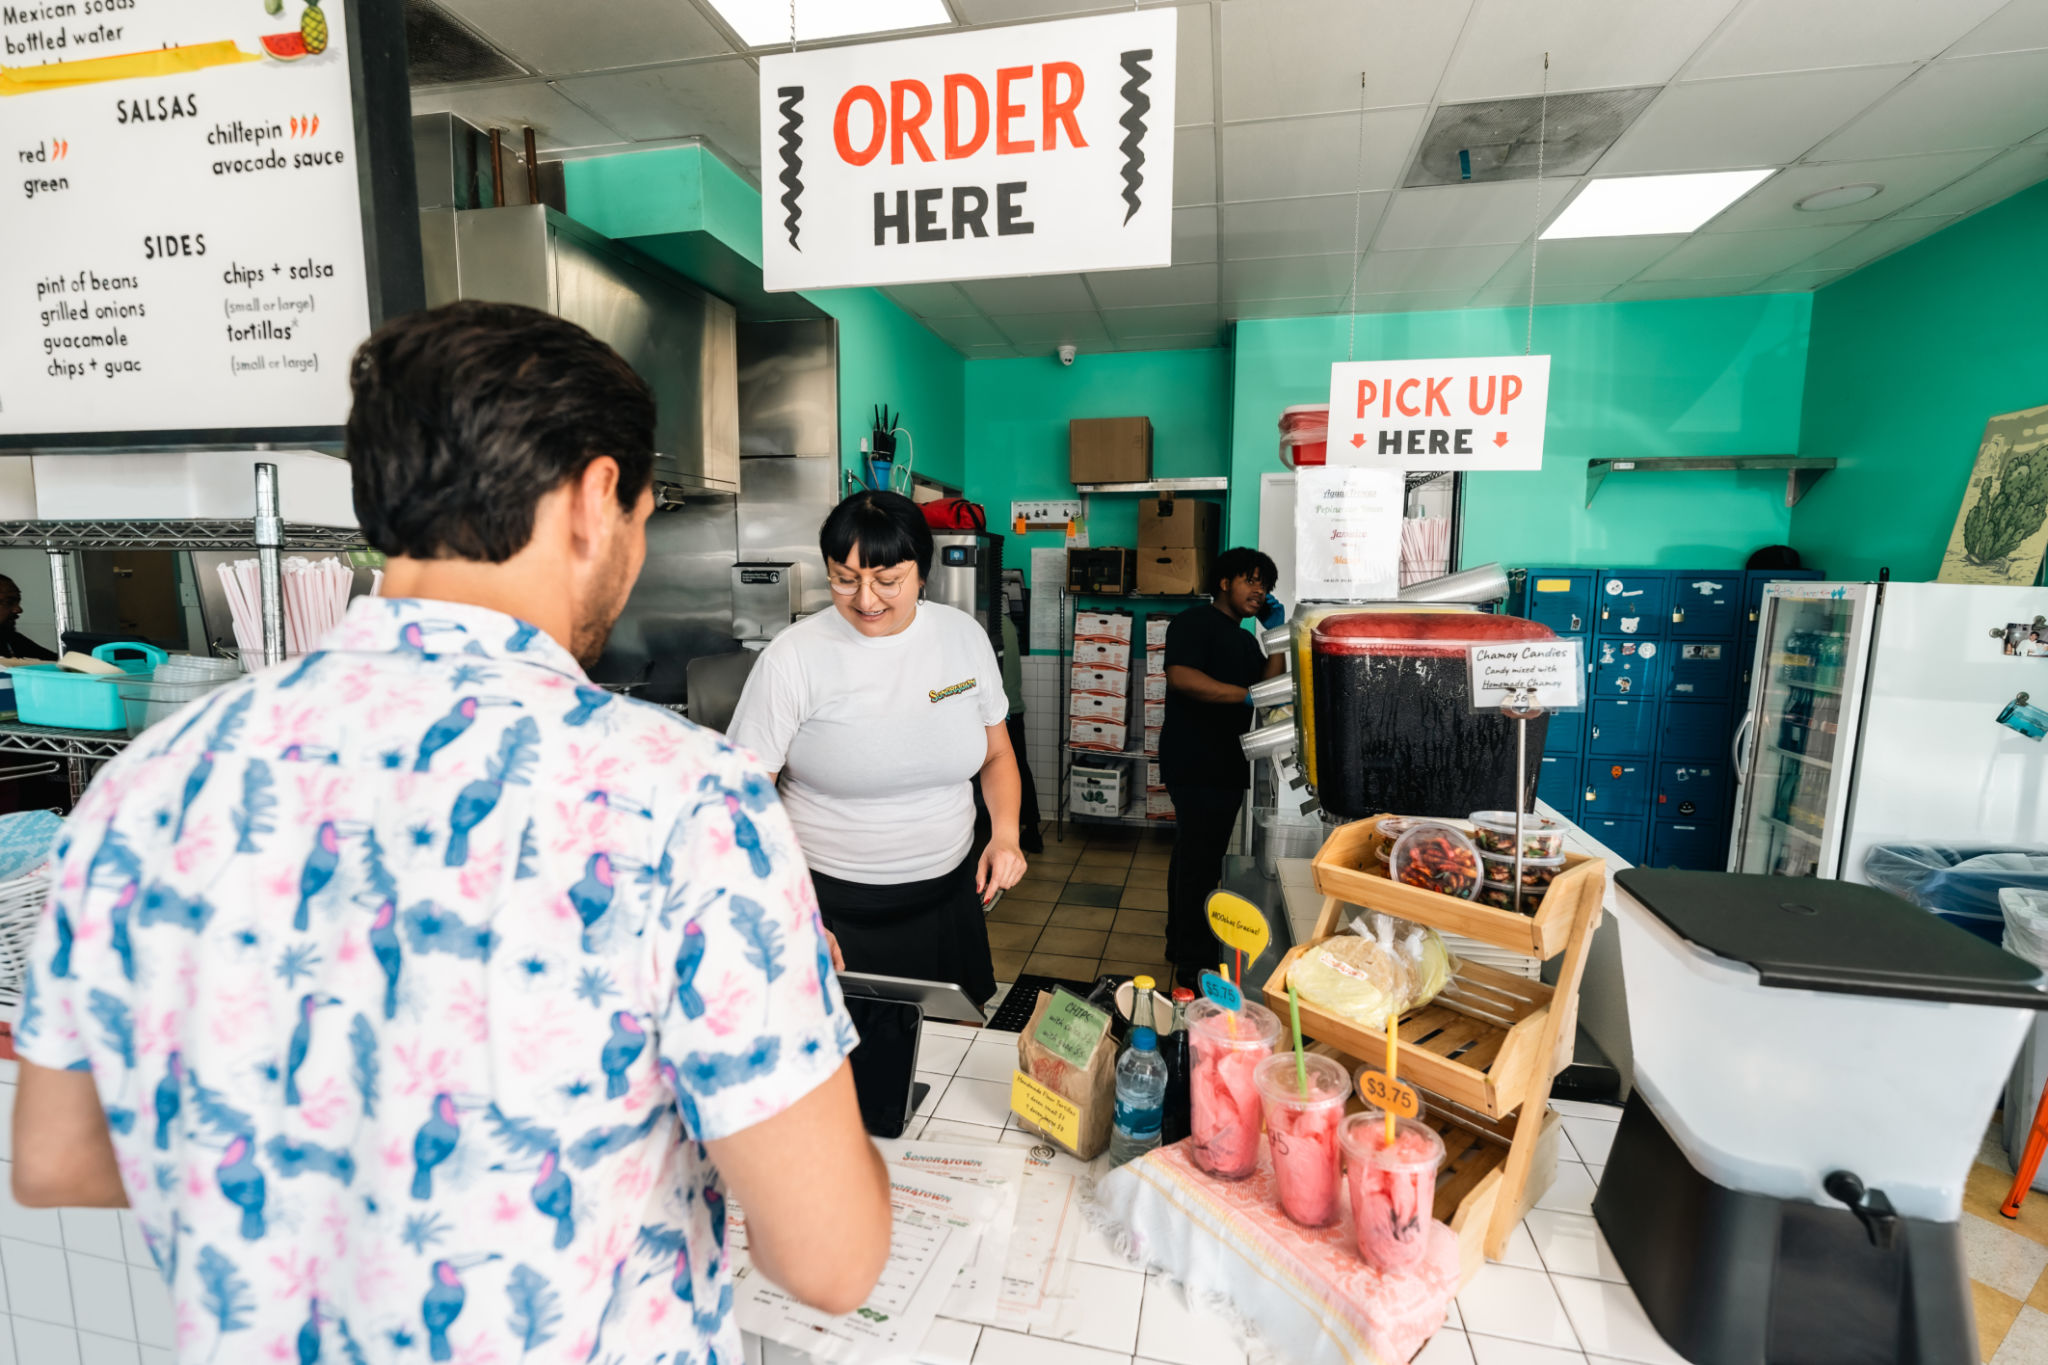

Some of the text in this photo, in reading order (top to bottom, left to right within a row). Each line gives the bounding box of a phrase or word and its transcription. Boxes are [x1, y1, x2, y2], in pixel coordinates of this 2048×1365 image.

[4, 2, 76, 25] Mexican
[5, 24, 123, 54] bottled water
[117, 94, 198, 123] SALSAS
[833, 61, 1089, 166] ORDER
[207, 120, 282, 146] chiltepin
[19, 142, 46, 163] red
[212, 148, 344, 175] avocado sauce
[24, 176, 69, 198] green
[874, 181, 1034, 246] HERE
[144, 234, 207, 259] SIDES
[37, 271, 138, 299] pint of beans
[223, 261, 264, 288] chips
[290, 258, 334, 279] salsa
[40, 300, 146, 326] grilled onions
[224, 294, 315, 319] (small or large)
[43, 327, 129, 355] guacamole
[47, 358, 85, 378] chips
[104, 360, 142, 378] guac
[231, 353, 318, 376] (small or large)
[1357, 375, 1523, 419] PICK UP
[1378, 428, 1473, 455] HERE
[1476, 647, 1568, 662] Chamoy Candies
[1482, 678, 1562, 689] Homemade Chamoy
[1484, 666, 1509, 676] Candy
[1538, 665, 1557, 673] with
[1206, 981, 1236, 1003] $5.75
[1064, 1001, 1094, 1022] CHIPS
[1367, 1077, 1412, 1109] $3.75
